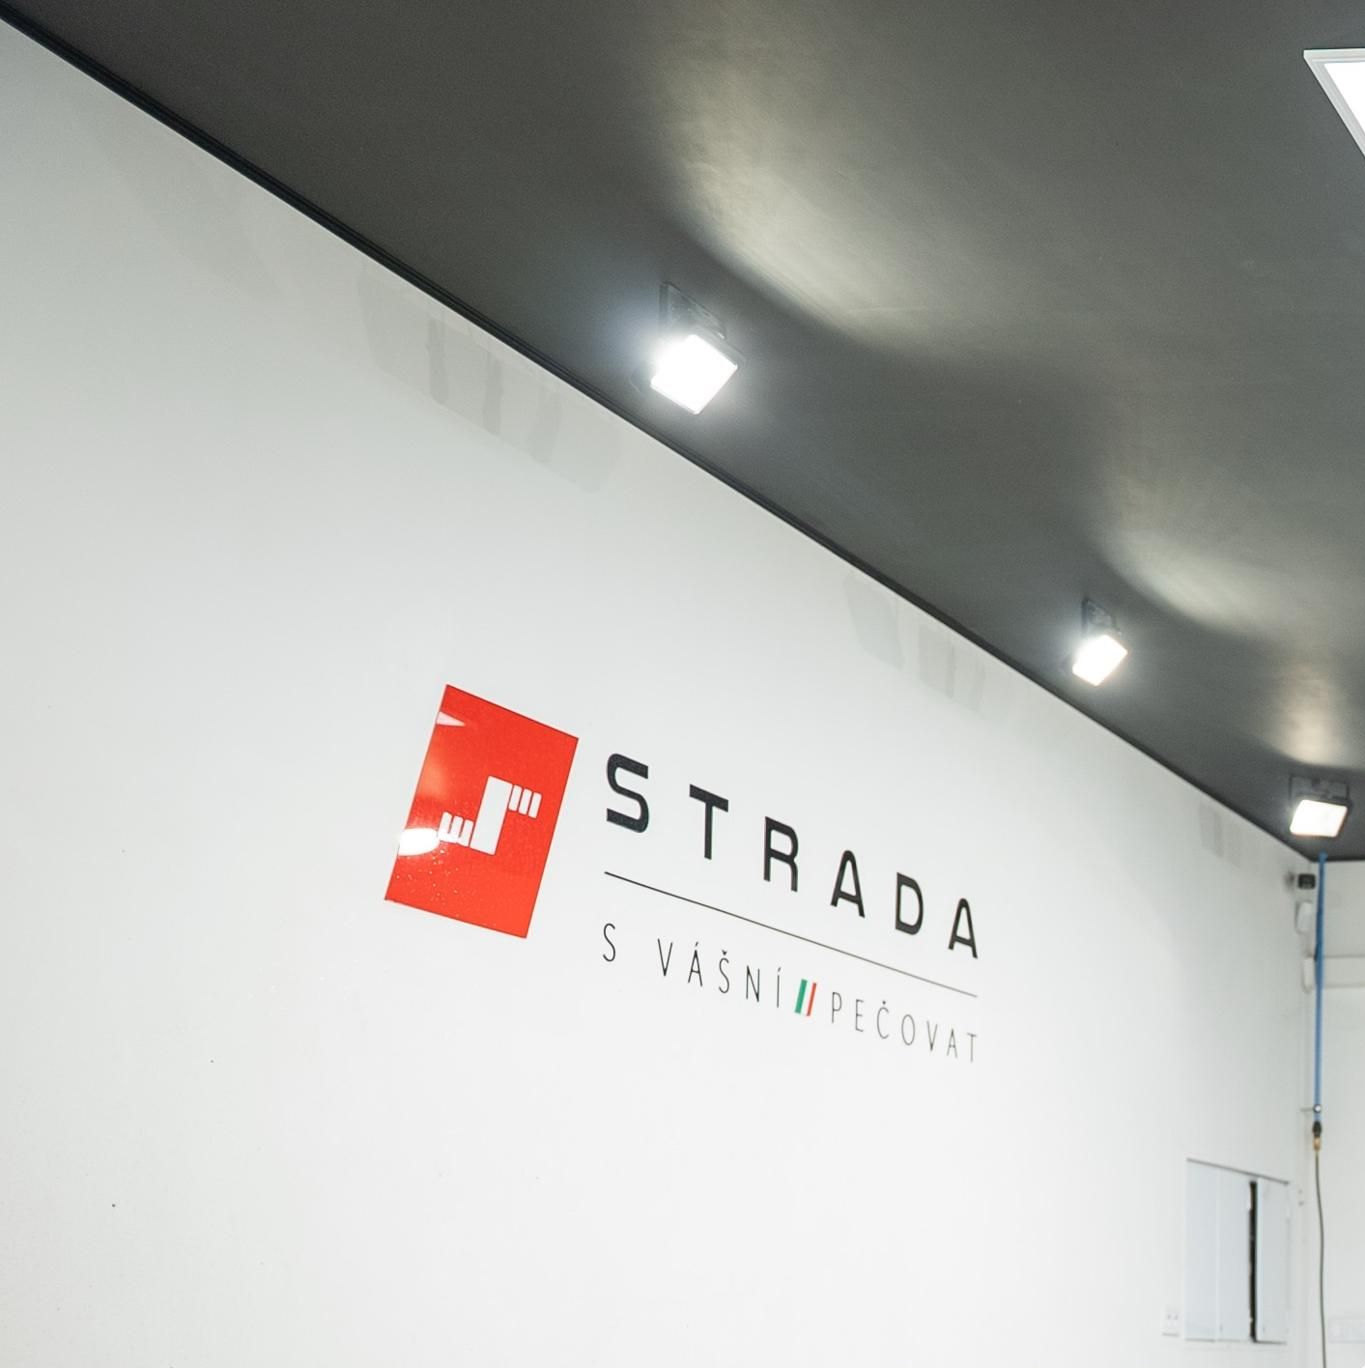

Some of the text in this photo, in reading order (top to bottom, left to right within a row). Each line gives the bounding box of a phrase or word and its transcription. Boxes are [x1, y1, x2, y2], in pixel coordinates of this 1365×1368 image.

[606, 752, 979, 959] STRADA
[602, 923, 978, 1063] S VÁŠNÍ PEČOVAT
